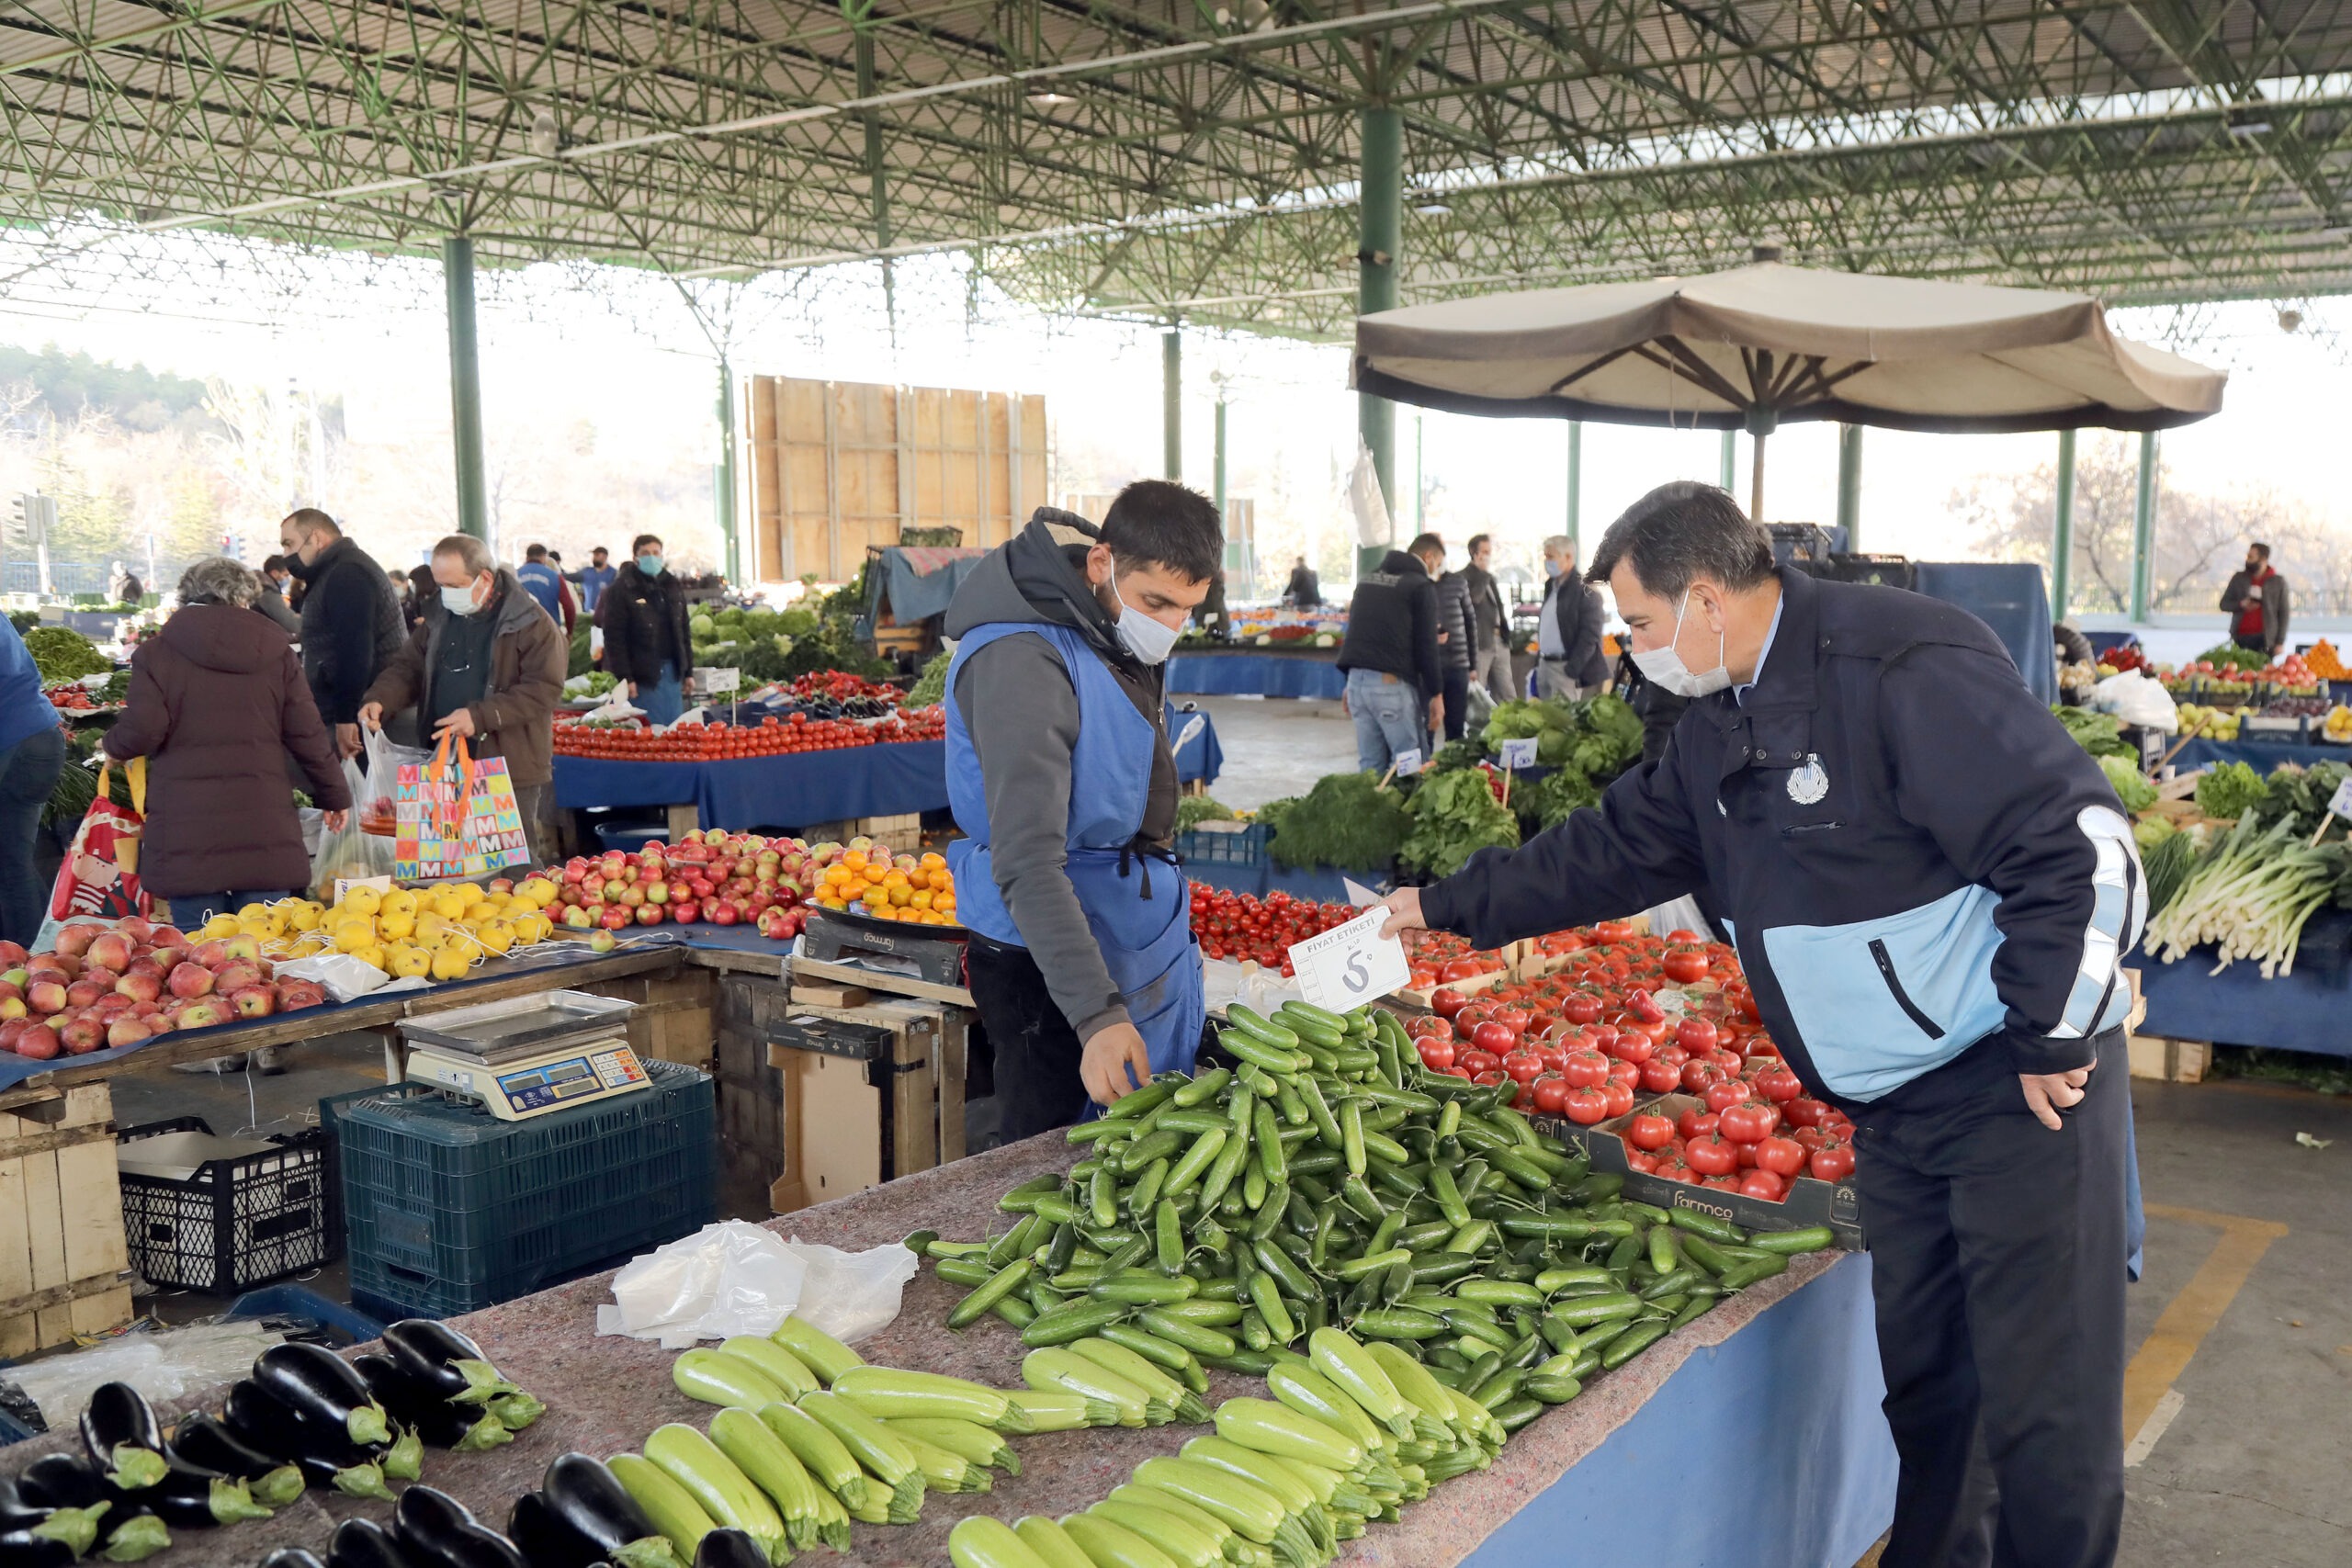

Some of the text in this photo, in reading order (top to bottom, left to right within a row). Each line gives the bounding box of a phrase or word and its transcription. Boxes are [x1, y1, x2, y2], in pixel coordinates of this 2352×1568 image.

[1306, 917, 1375, 953] FİYAT ETİKETİ
[1342, 949, 1369, 994] 5
